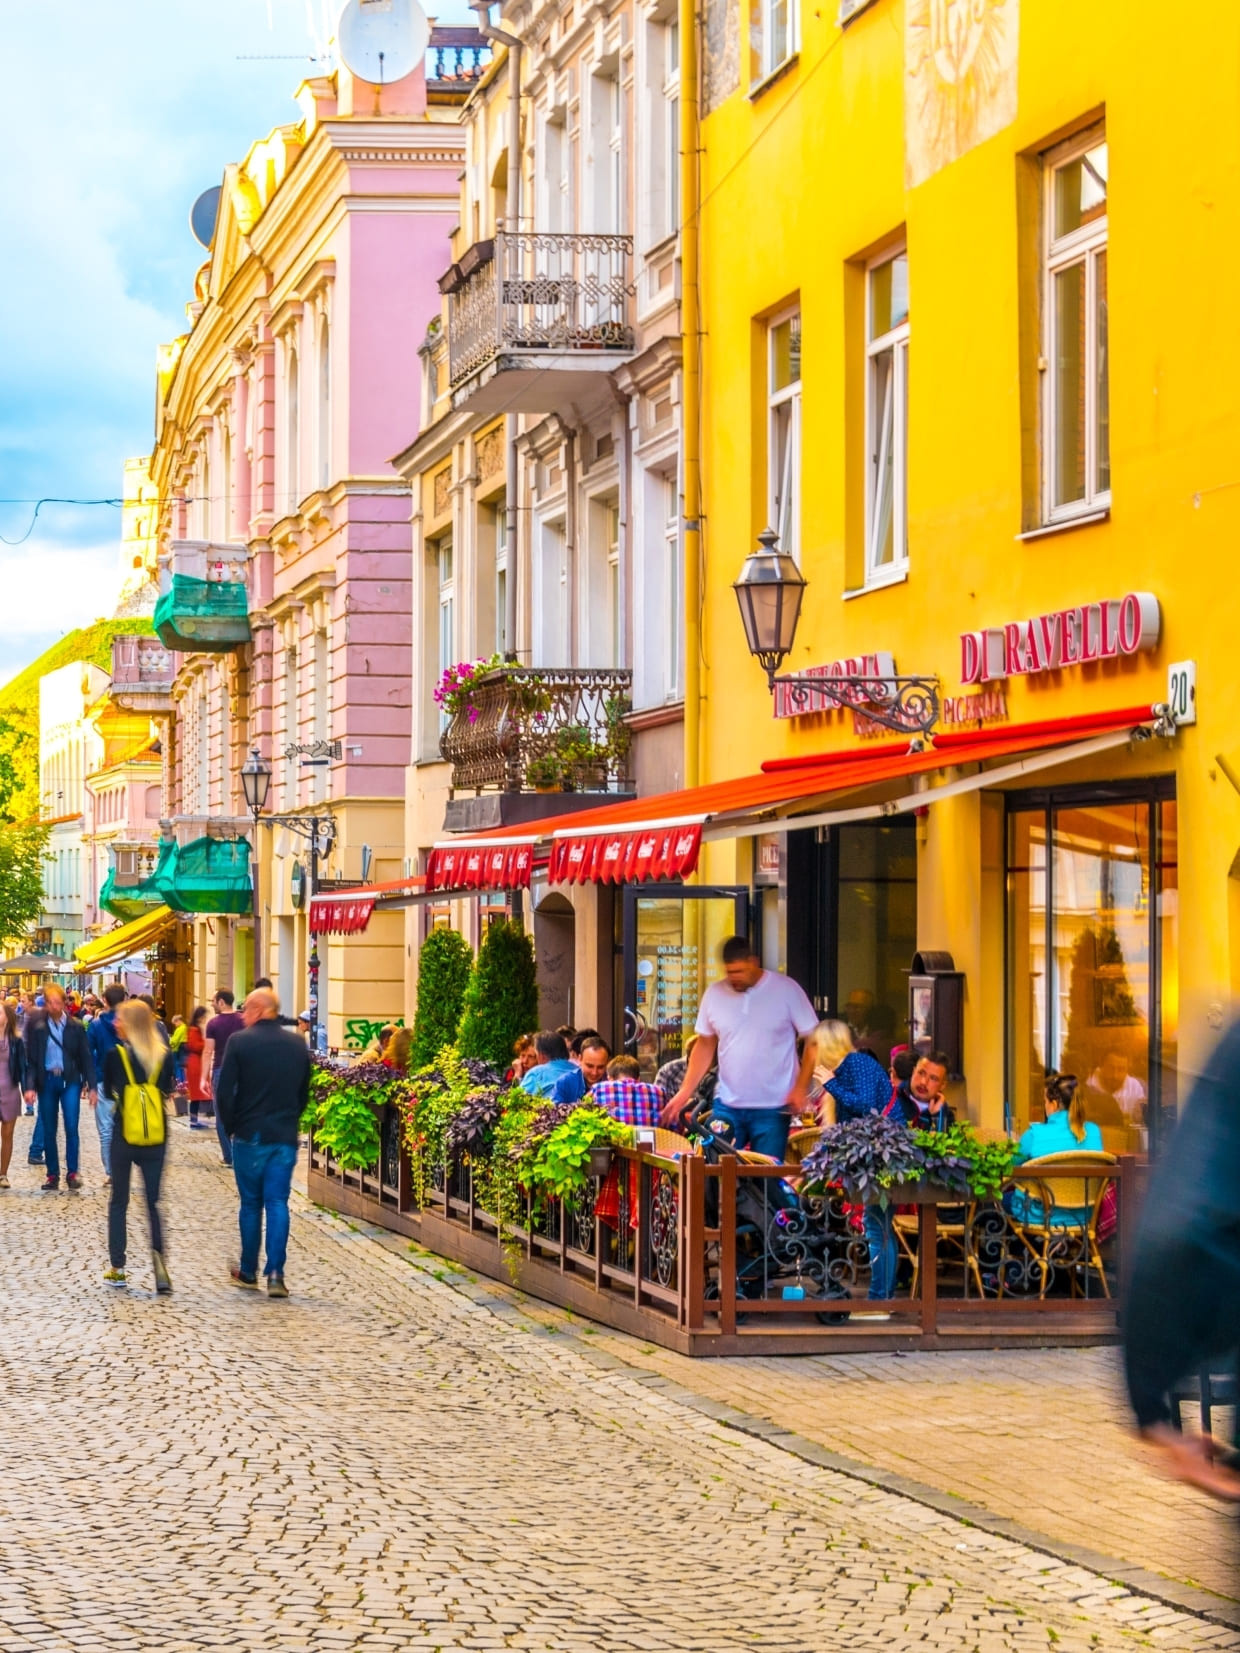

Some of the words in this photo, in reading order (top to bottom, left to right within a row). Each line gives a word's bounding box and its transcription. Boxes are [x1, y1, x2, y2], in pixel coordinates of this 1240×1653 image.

[960, 630, 990, 685] DI
[1004, 593, 1142, 677] RAVELLO
[1171, 671, 1188, 716] 20
